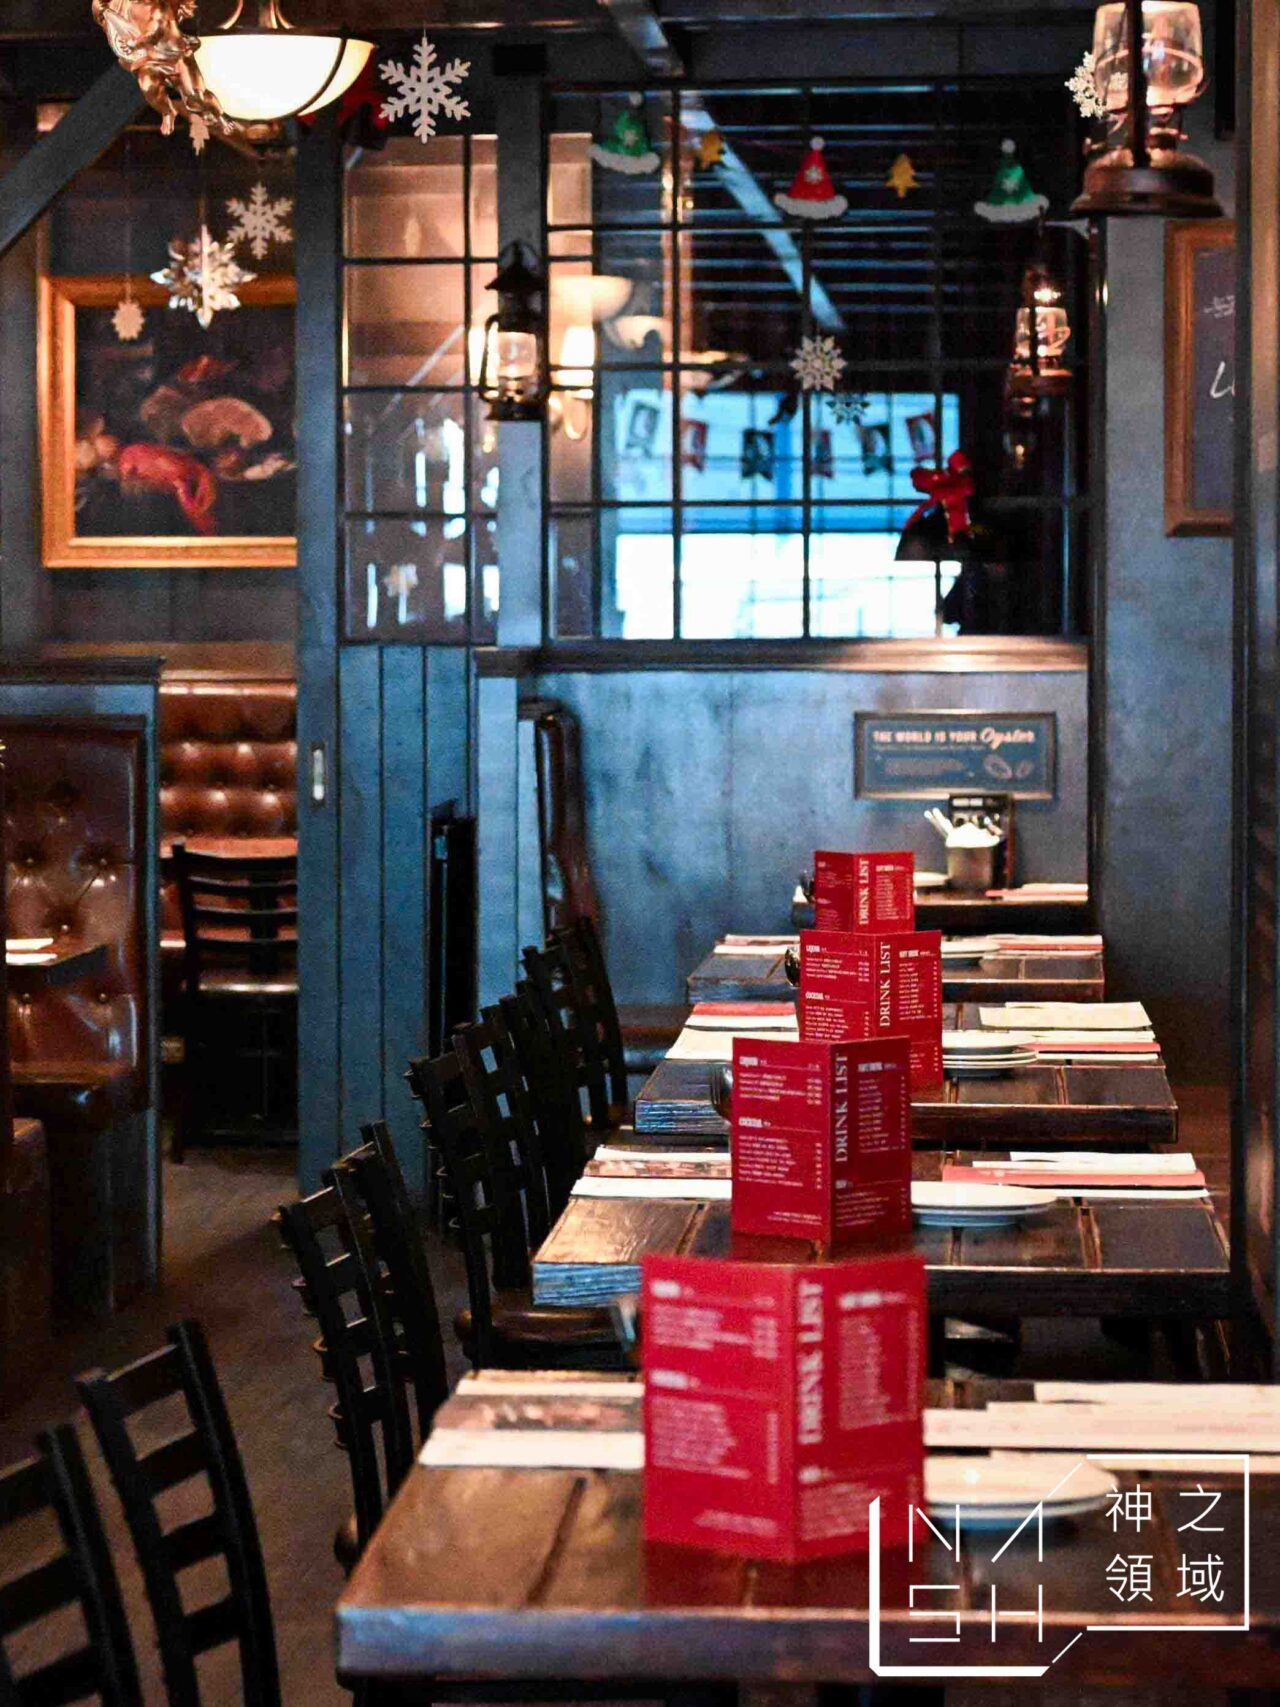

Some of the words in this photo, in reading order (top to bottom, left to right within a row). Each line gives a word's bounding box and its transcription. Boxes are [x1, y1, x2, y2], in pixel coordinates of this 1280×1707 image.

[873, 730, 892, 743] THE
[895, 730, 932, 743] WORLD
[934, 730, 946, 743] IS
[949, 730, 977, 743] YOUR
[980, 726, 1036, 750] Oyster
[858, 857, 870, 884] LIST
[858, 887, 870, 925] DRINK
[879, 941, 891, 974] LIST
[879, 979, 891, 1027] DRINK
[835, 1053, 848, 1094] LIST
[835, 1100, 848, 1162] DRINK
[797, 1278, 824, 1343] LIST
